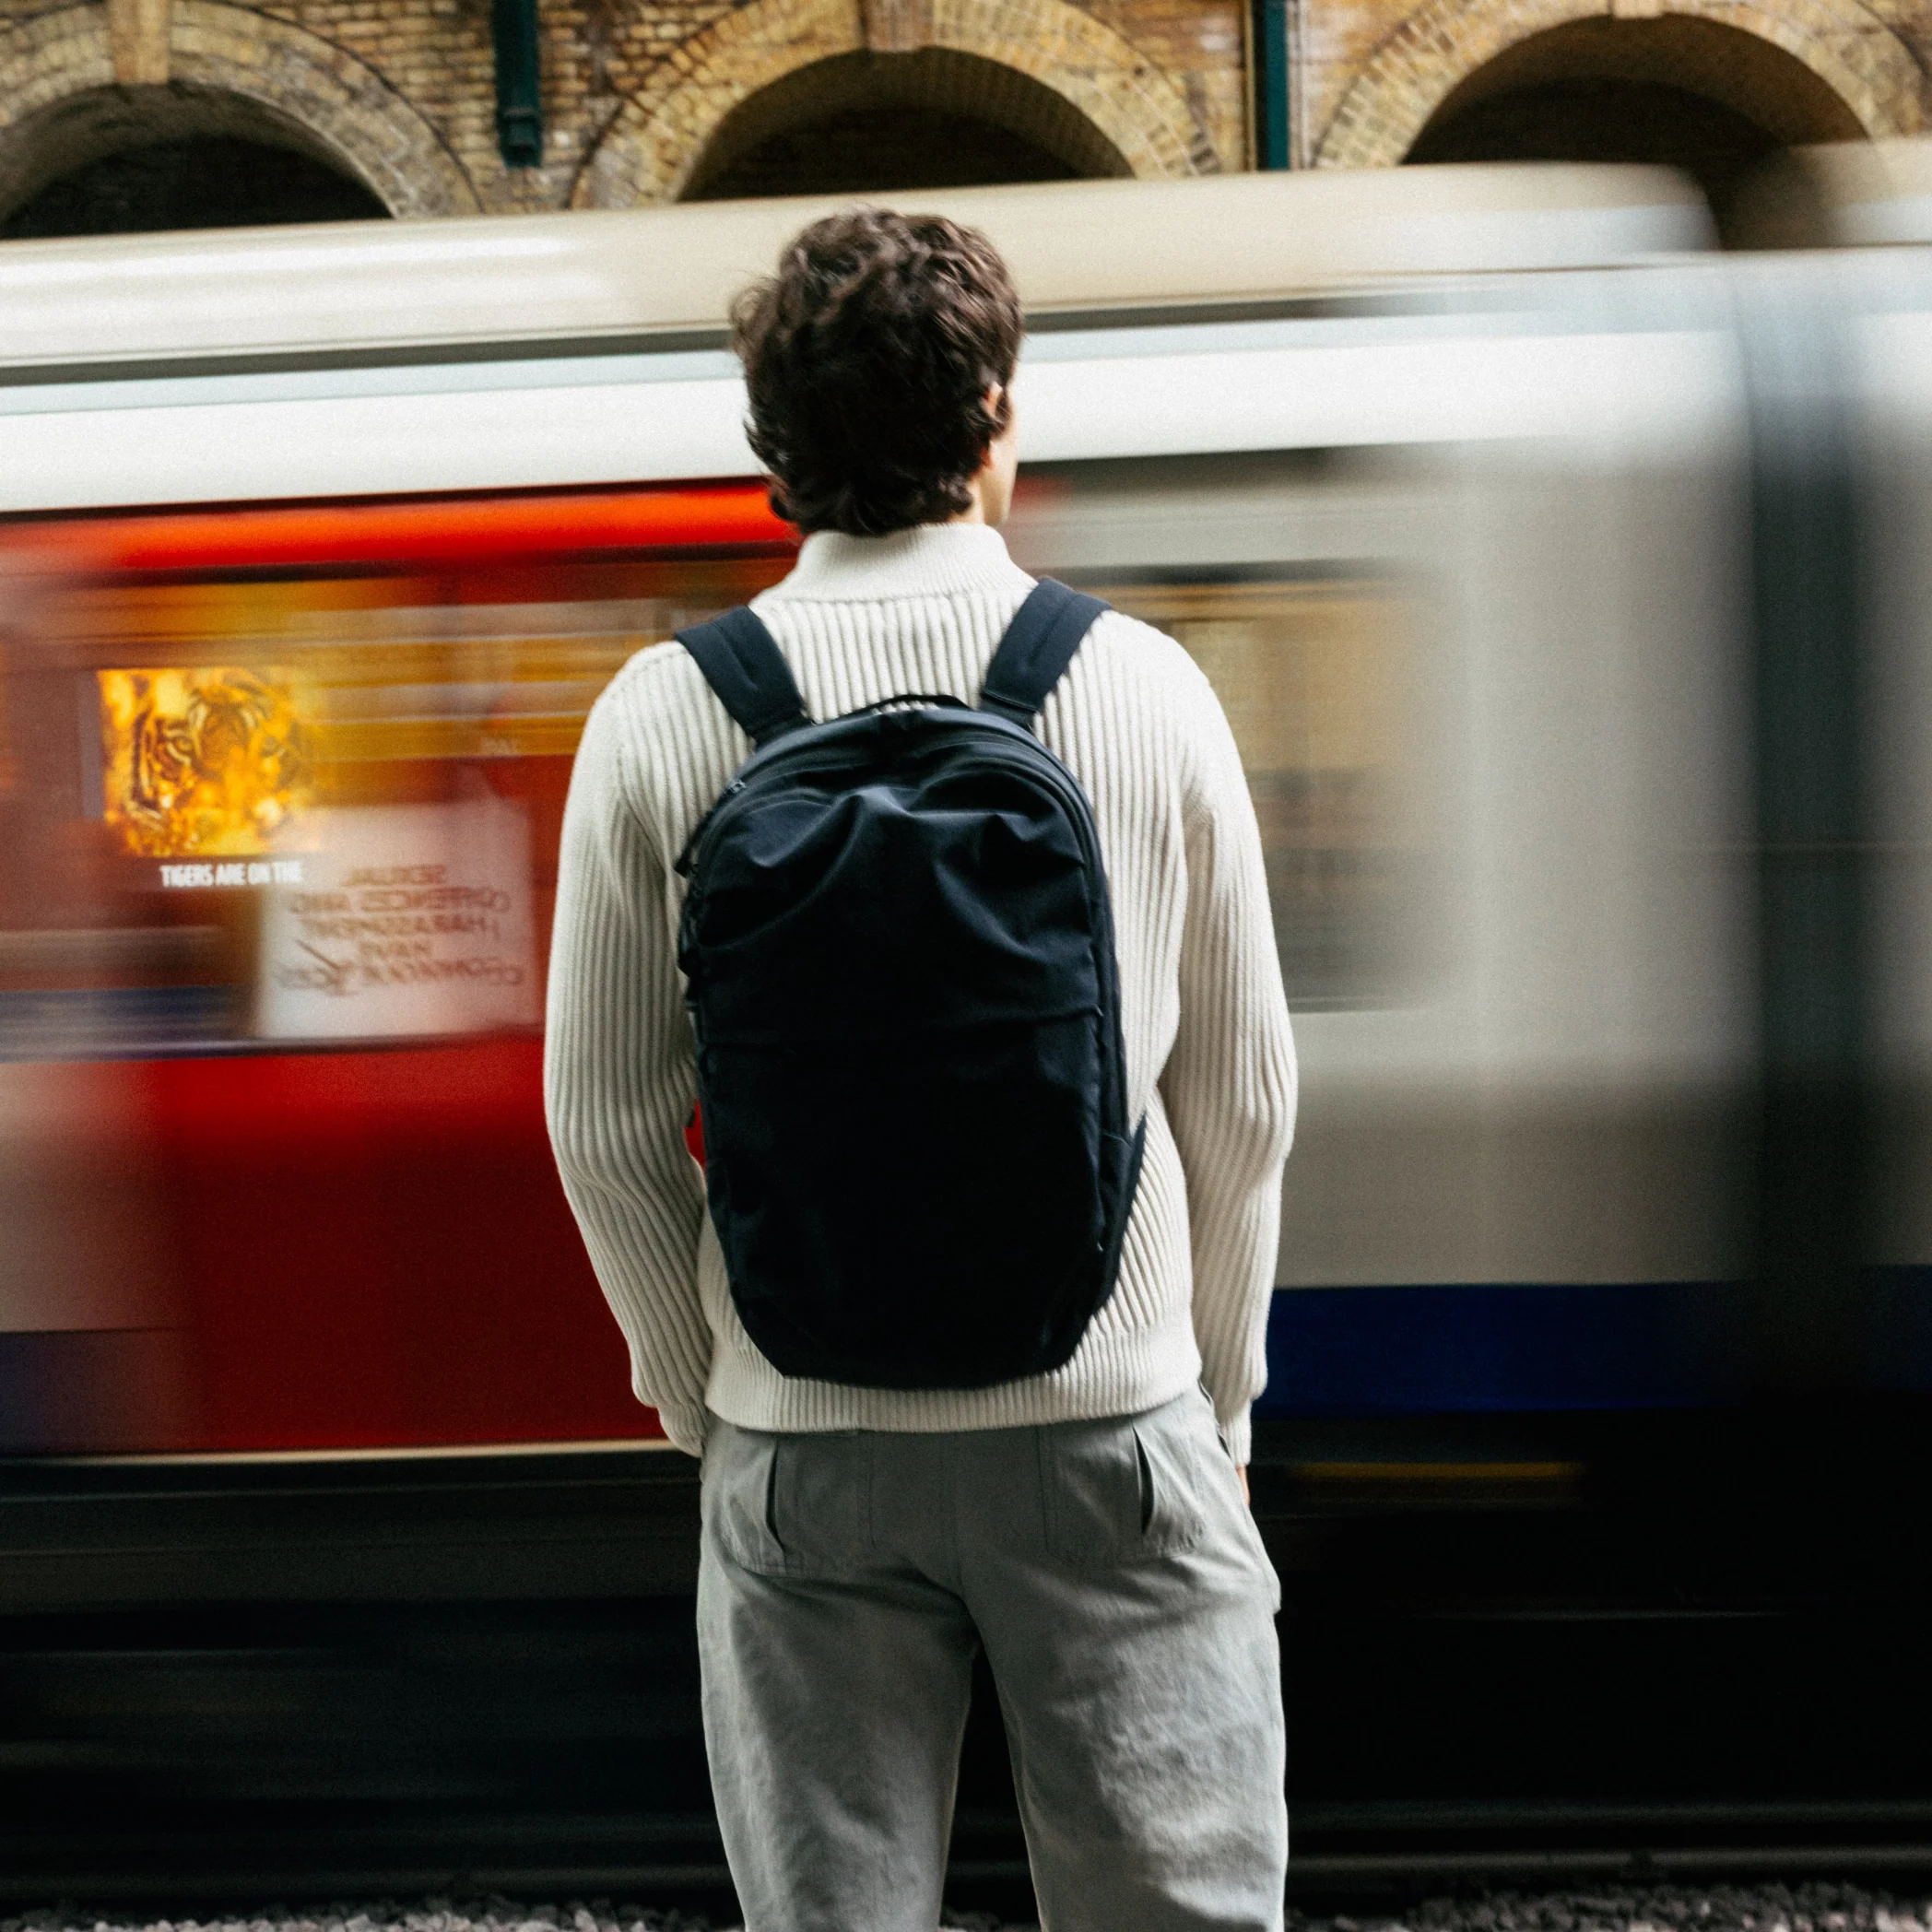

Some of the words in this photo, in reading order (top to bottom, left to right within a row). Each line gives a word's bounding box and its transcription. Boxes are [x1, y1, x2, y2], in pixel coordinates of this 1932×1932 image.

[159, 864, 214, 887] TIGERS
[216, 863, 245, 885] ARE
[248, 863, 271, 884] ON
[273, 861, 302, 883] THE
